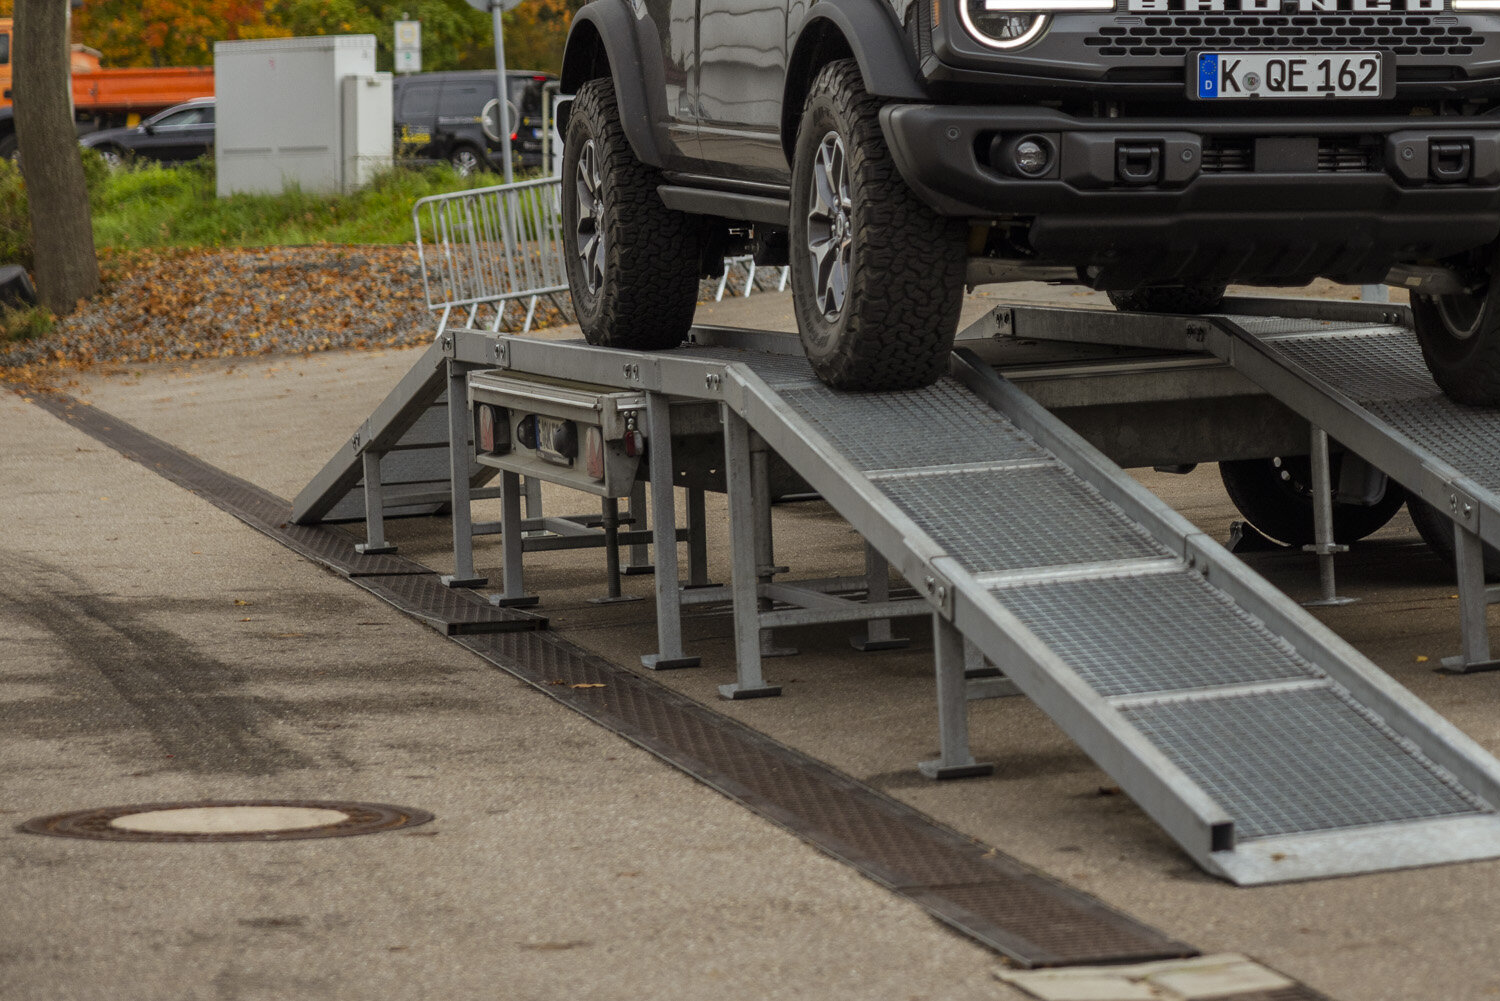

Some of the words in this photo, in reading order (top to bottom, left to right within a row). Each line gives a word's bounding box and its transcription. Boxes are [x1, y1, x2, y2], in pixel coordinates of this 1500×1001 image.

[1204, 80, 1213, 90] D
[1221, 59, 1242, 93] K
[1265, 59, 1309, 93] QE
[1316, 59, 1378, 92] 162
